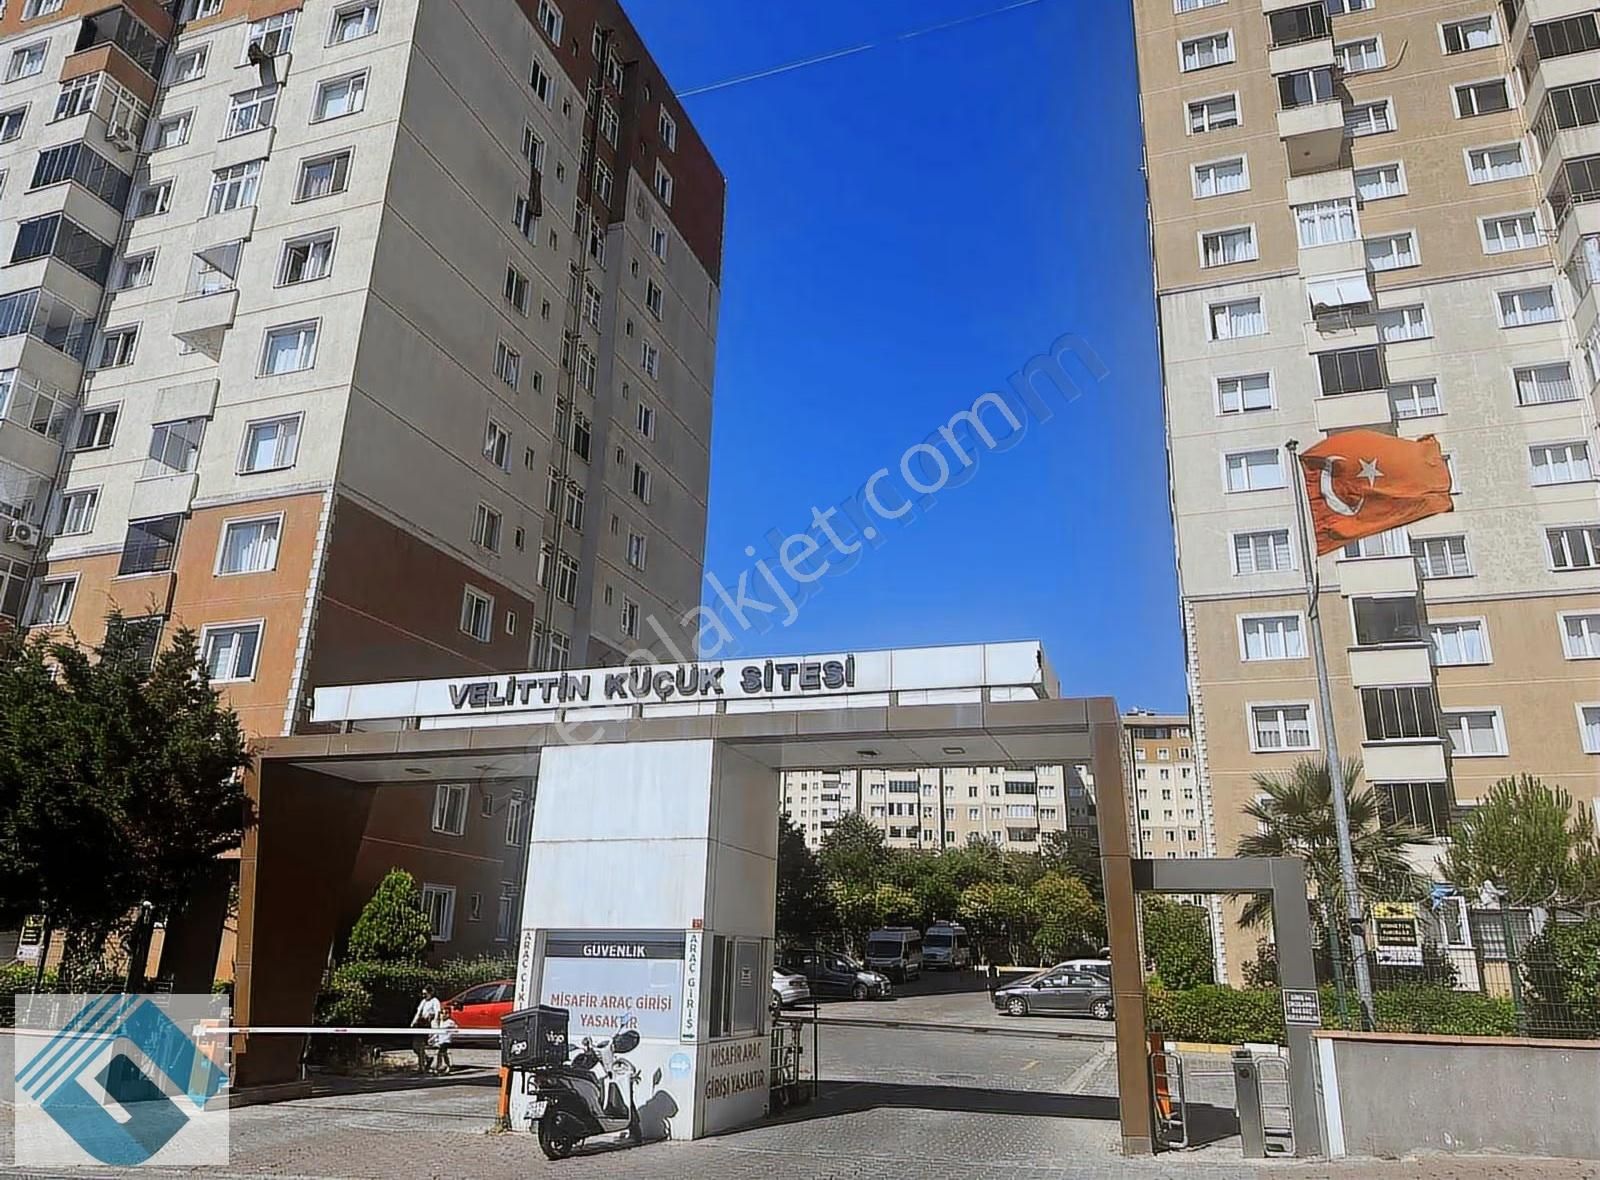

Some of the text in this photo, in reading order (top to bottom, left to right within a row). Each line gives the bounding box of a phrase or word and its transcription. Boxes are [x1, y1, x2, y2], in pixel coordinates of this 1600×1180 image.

[604, 663, 724, 703] KÜÇÜK
[740, 654, 855, 693] SİTESİ
[550, 991, 672, 1012] MİSAFİR ARAÇ GİRİŞİ
